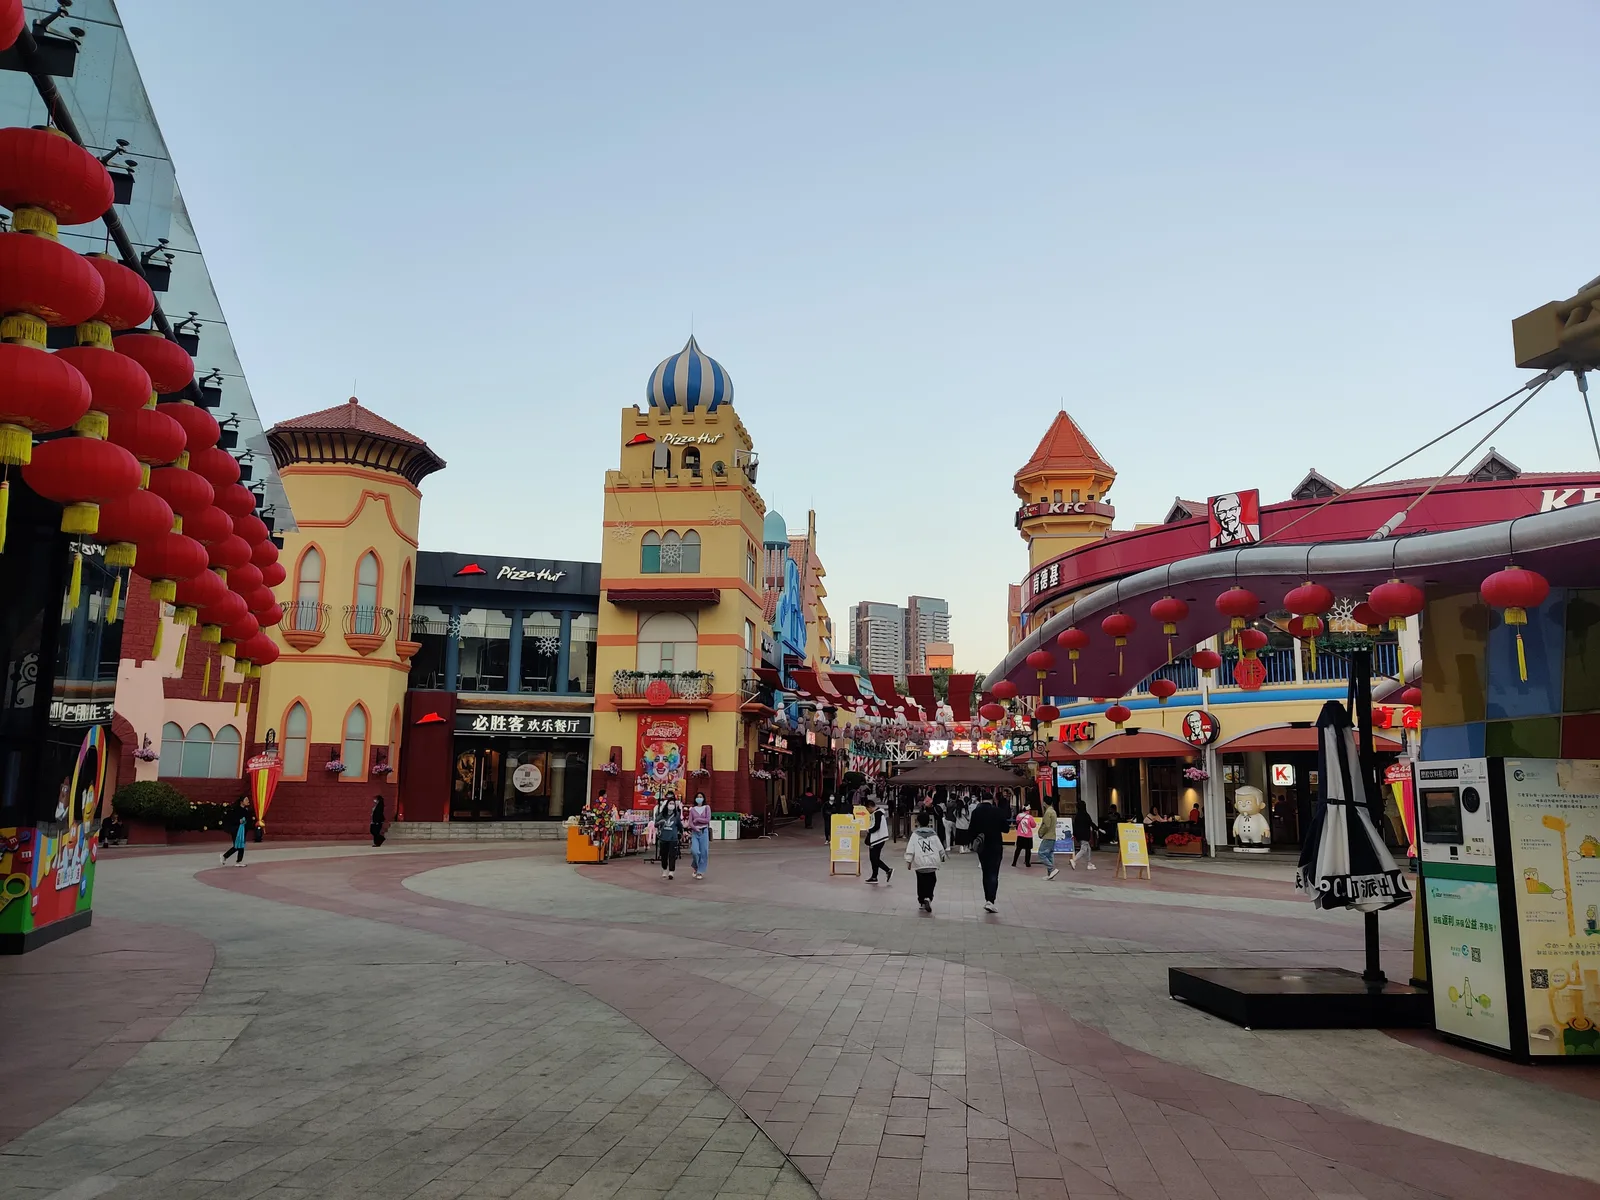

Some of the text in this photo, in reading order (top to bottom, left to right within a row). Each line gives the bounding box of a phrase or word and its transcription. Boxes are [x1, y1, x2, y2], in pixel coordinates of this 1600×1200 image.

[662, 433, 724, 445] Pizza Hut
[1048, 502, 1086, 513] KFC
[497, 566, 566, 581] Pizza Hut
[1033, 563, 1059, 594] 肯德基
[472, 714, 580, 732] 必胜客 欢乐餐厅
[1058, 721, 1089, 743] KFC
[1013, 736, 1028, 745] 多多
[1275, 766, 1289, 781] K
